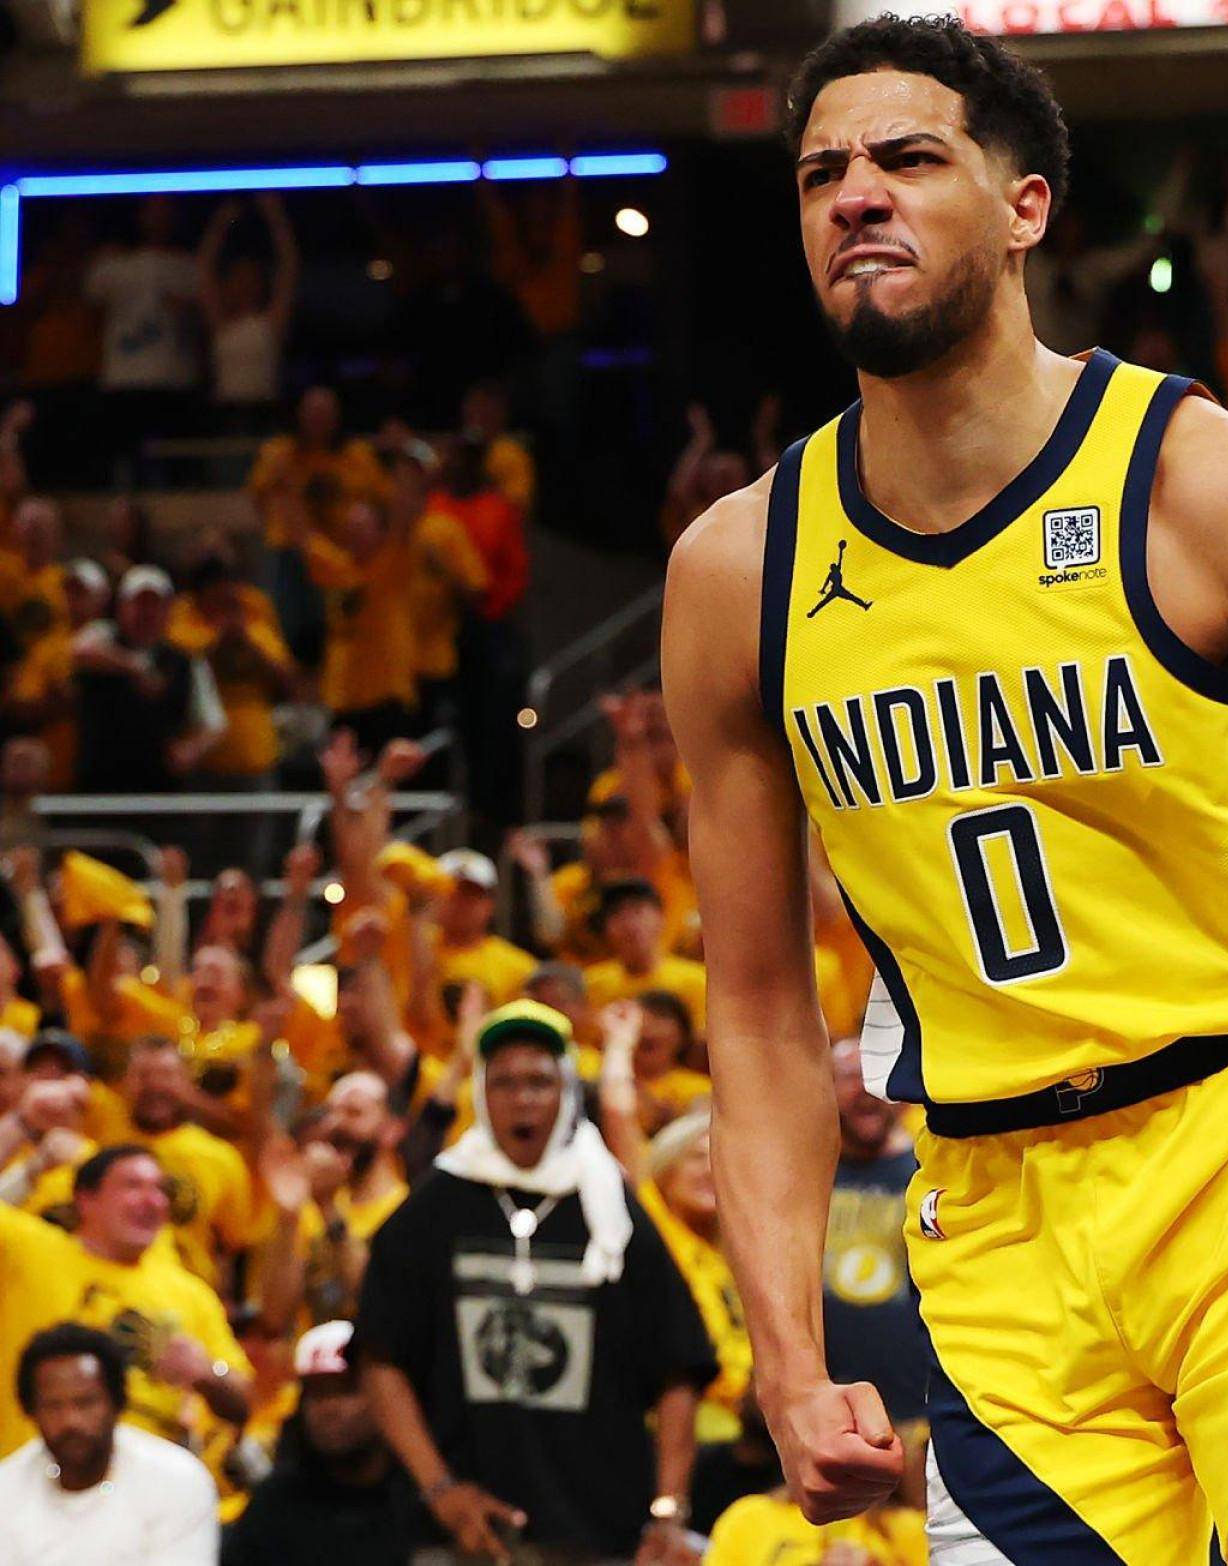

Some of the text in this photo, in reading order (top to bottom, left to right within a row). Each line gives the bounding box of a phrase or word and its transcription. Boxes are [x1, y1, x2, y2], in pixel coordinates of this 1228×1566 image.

[962, 0, 1178, 36] LOCAL
[1038, 567, 1108, 588] spokenote
[792, 653, 1166, 811] INDIANA
[946, 801, 1071, 988] 0
